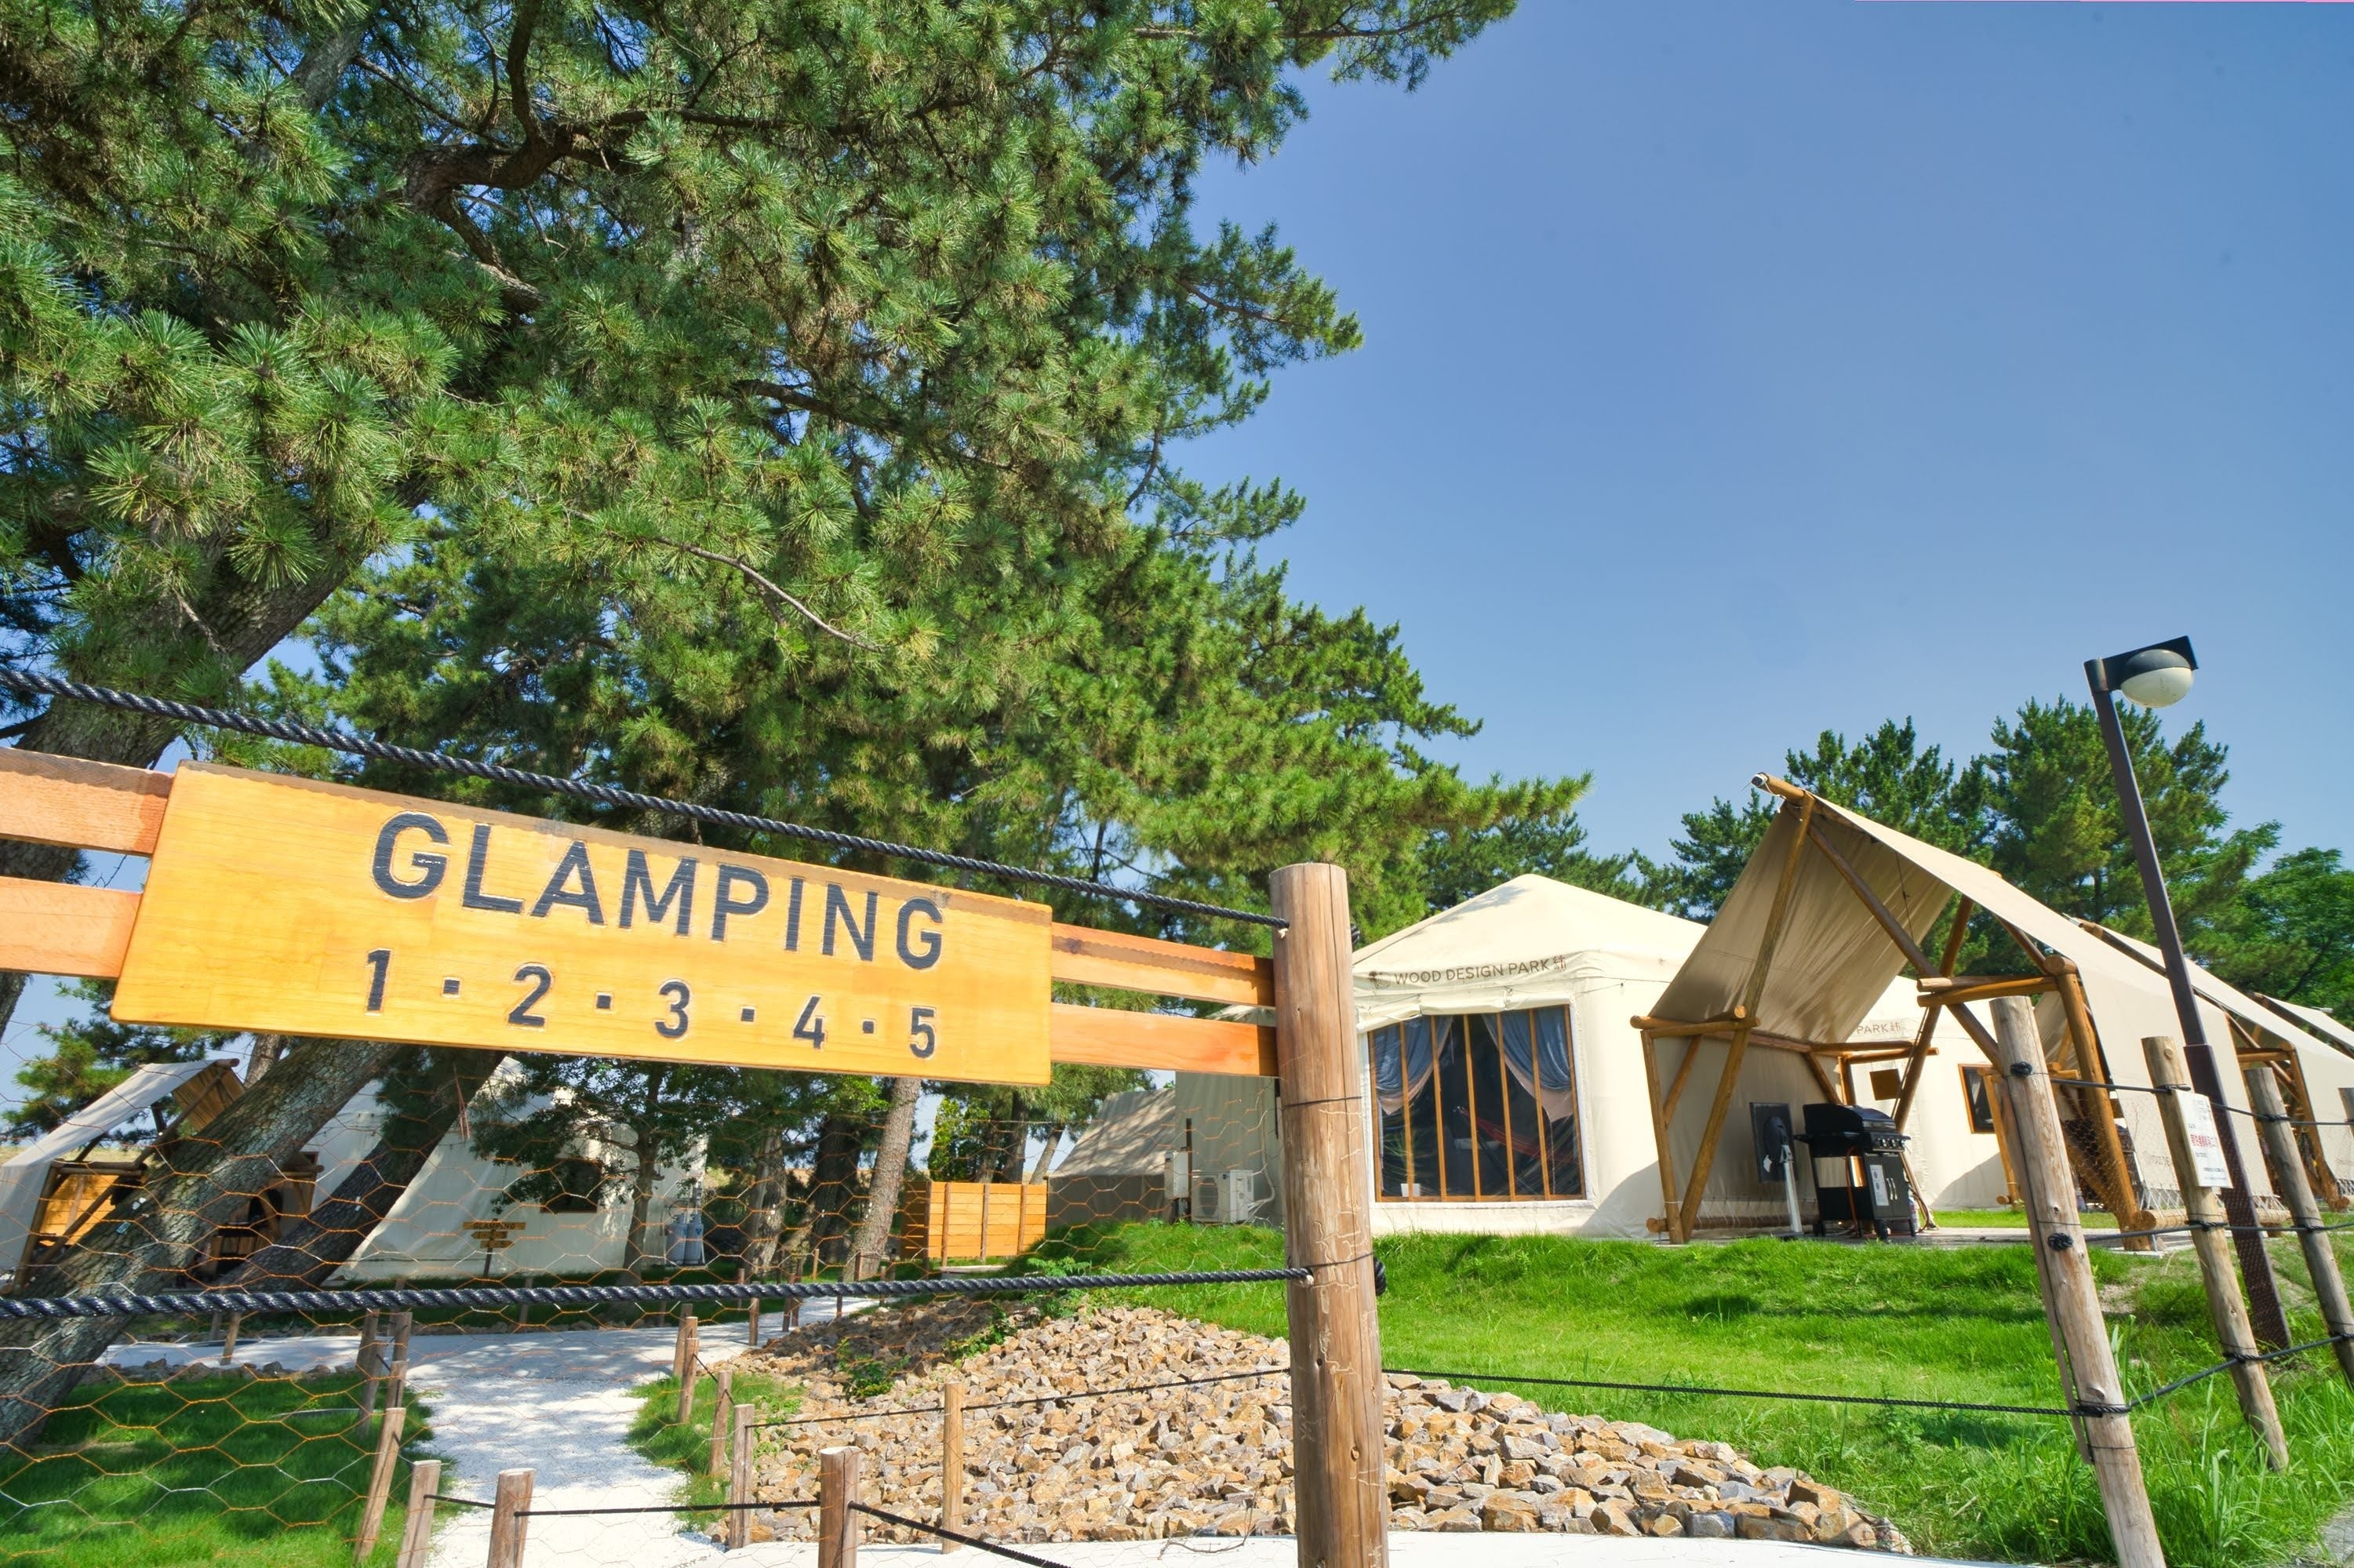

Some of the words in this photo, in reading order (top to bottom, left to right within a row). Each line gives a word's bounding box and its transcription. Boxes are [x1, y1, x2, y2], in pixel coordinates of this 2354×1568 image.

[372, 811, 944, 970] GLAMPING
[1394, 970, 1442, 984] WOOD
[1446, 965, 1504, 980] DESIGN
[1508, 959, 1550, 975] PARK
[1857, 1024, 1889, 1035] PARK
